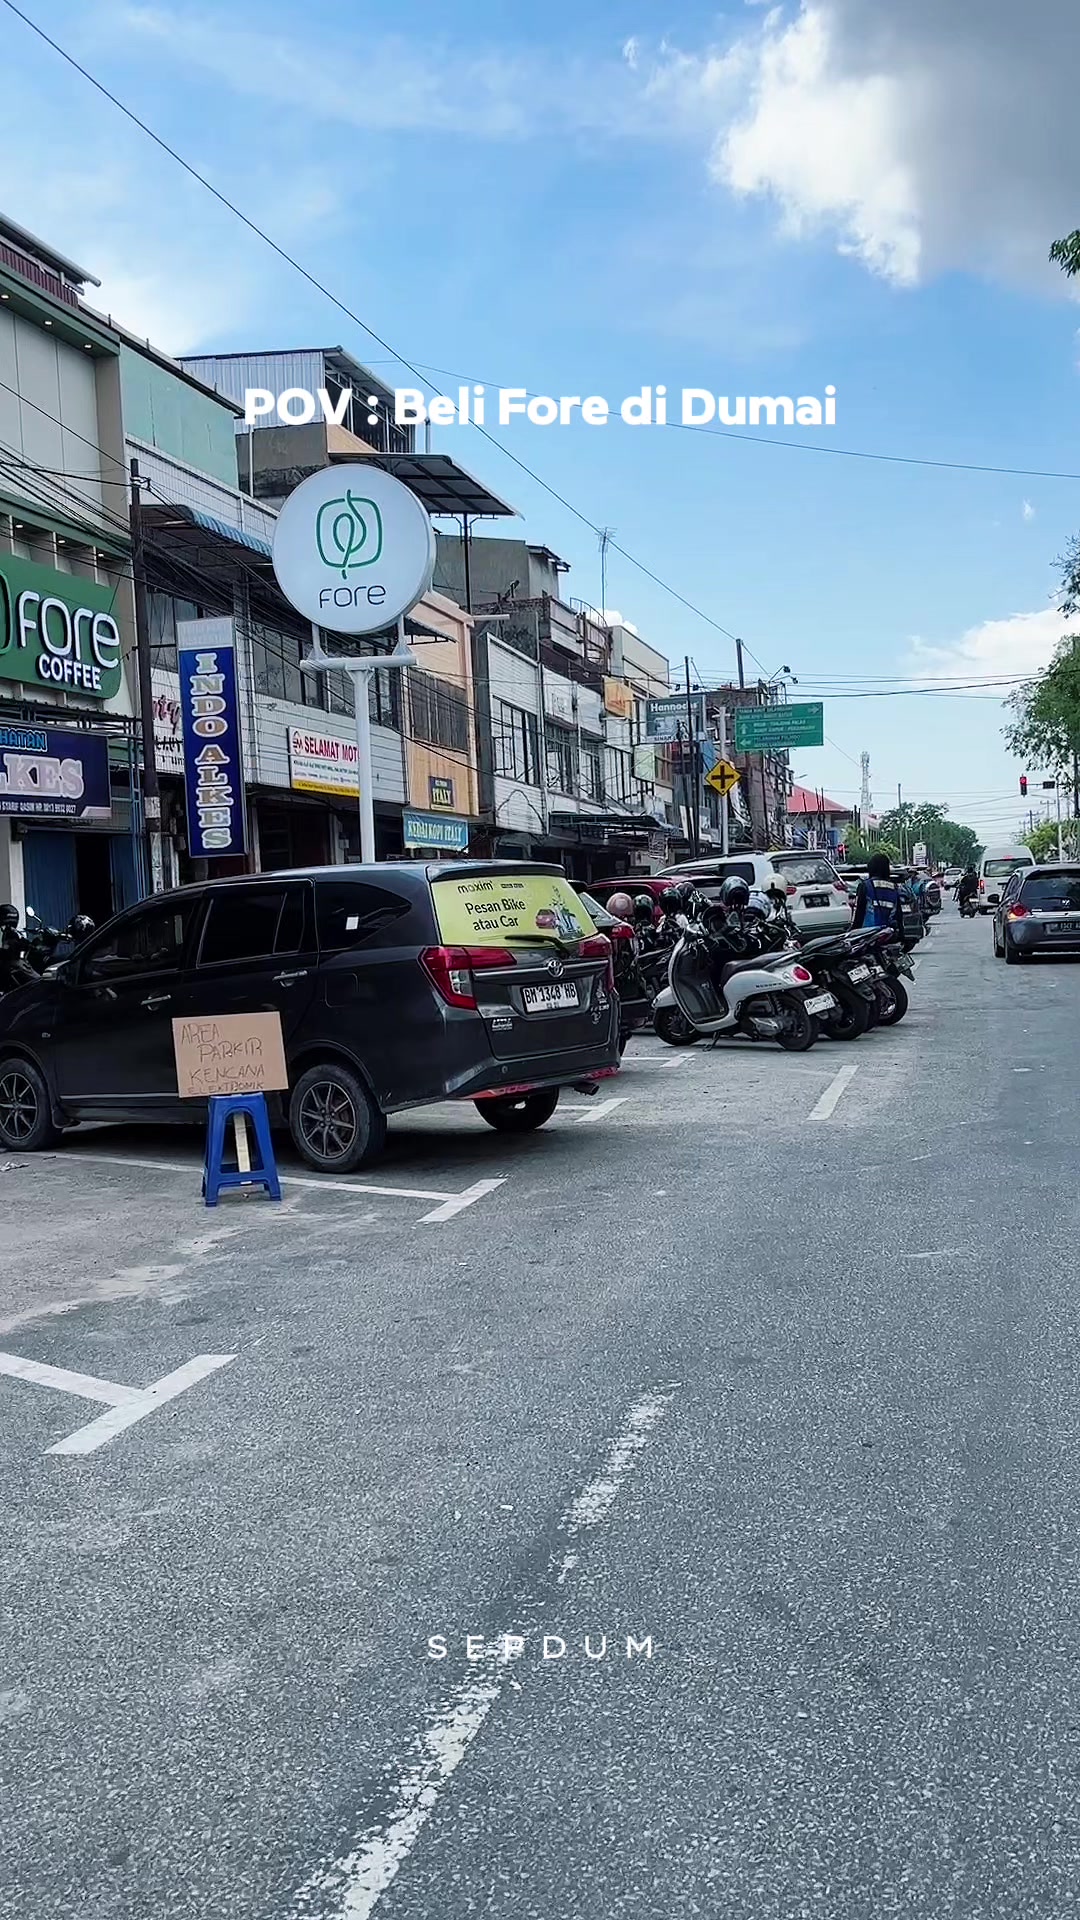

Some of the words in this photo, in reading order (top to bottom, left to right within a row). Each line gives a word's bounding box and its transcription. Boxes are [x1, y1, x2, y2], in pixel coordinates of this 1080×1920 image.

[38, 654, 102, 691] COFFEE
[190, 652, 228, 738] INDO
[304, 735, 339, 760] SELAMAT
[194, 743, 234, 850] ALKES
[464, 902, 501, 915] Pesan
[501, 898, 527, 912] Bike
[472, 917, 499, 932] atau
[500, 915, 519, 928] Car
[524, 987, 538, 1005] BM
[539, 984, 562, 1002] 1348
[181, 1023, 220, 1045] AREA
[197, 1036, 263, 1063] PARKIR
[189, 1063, 265, 1086] KENCANA
